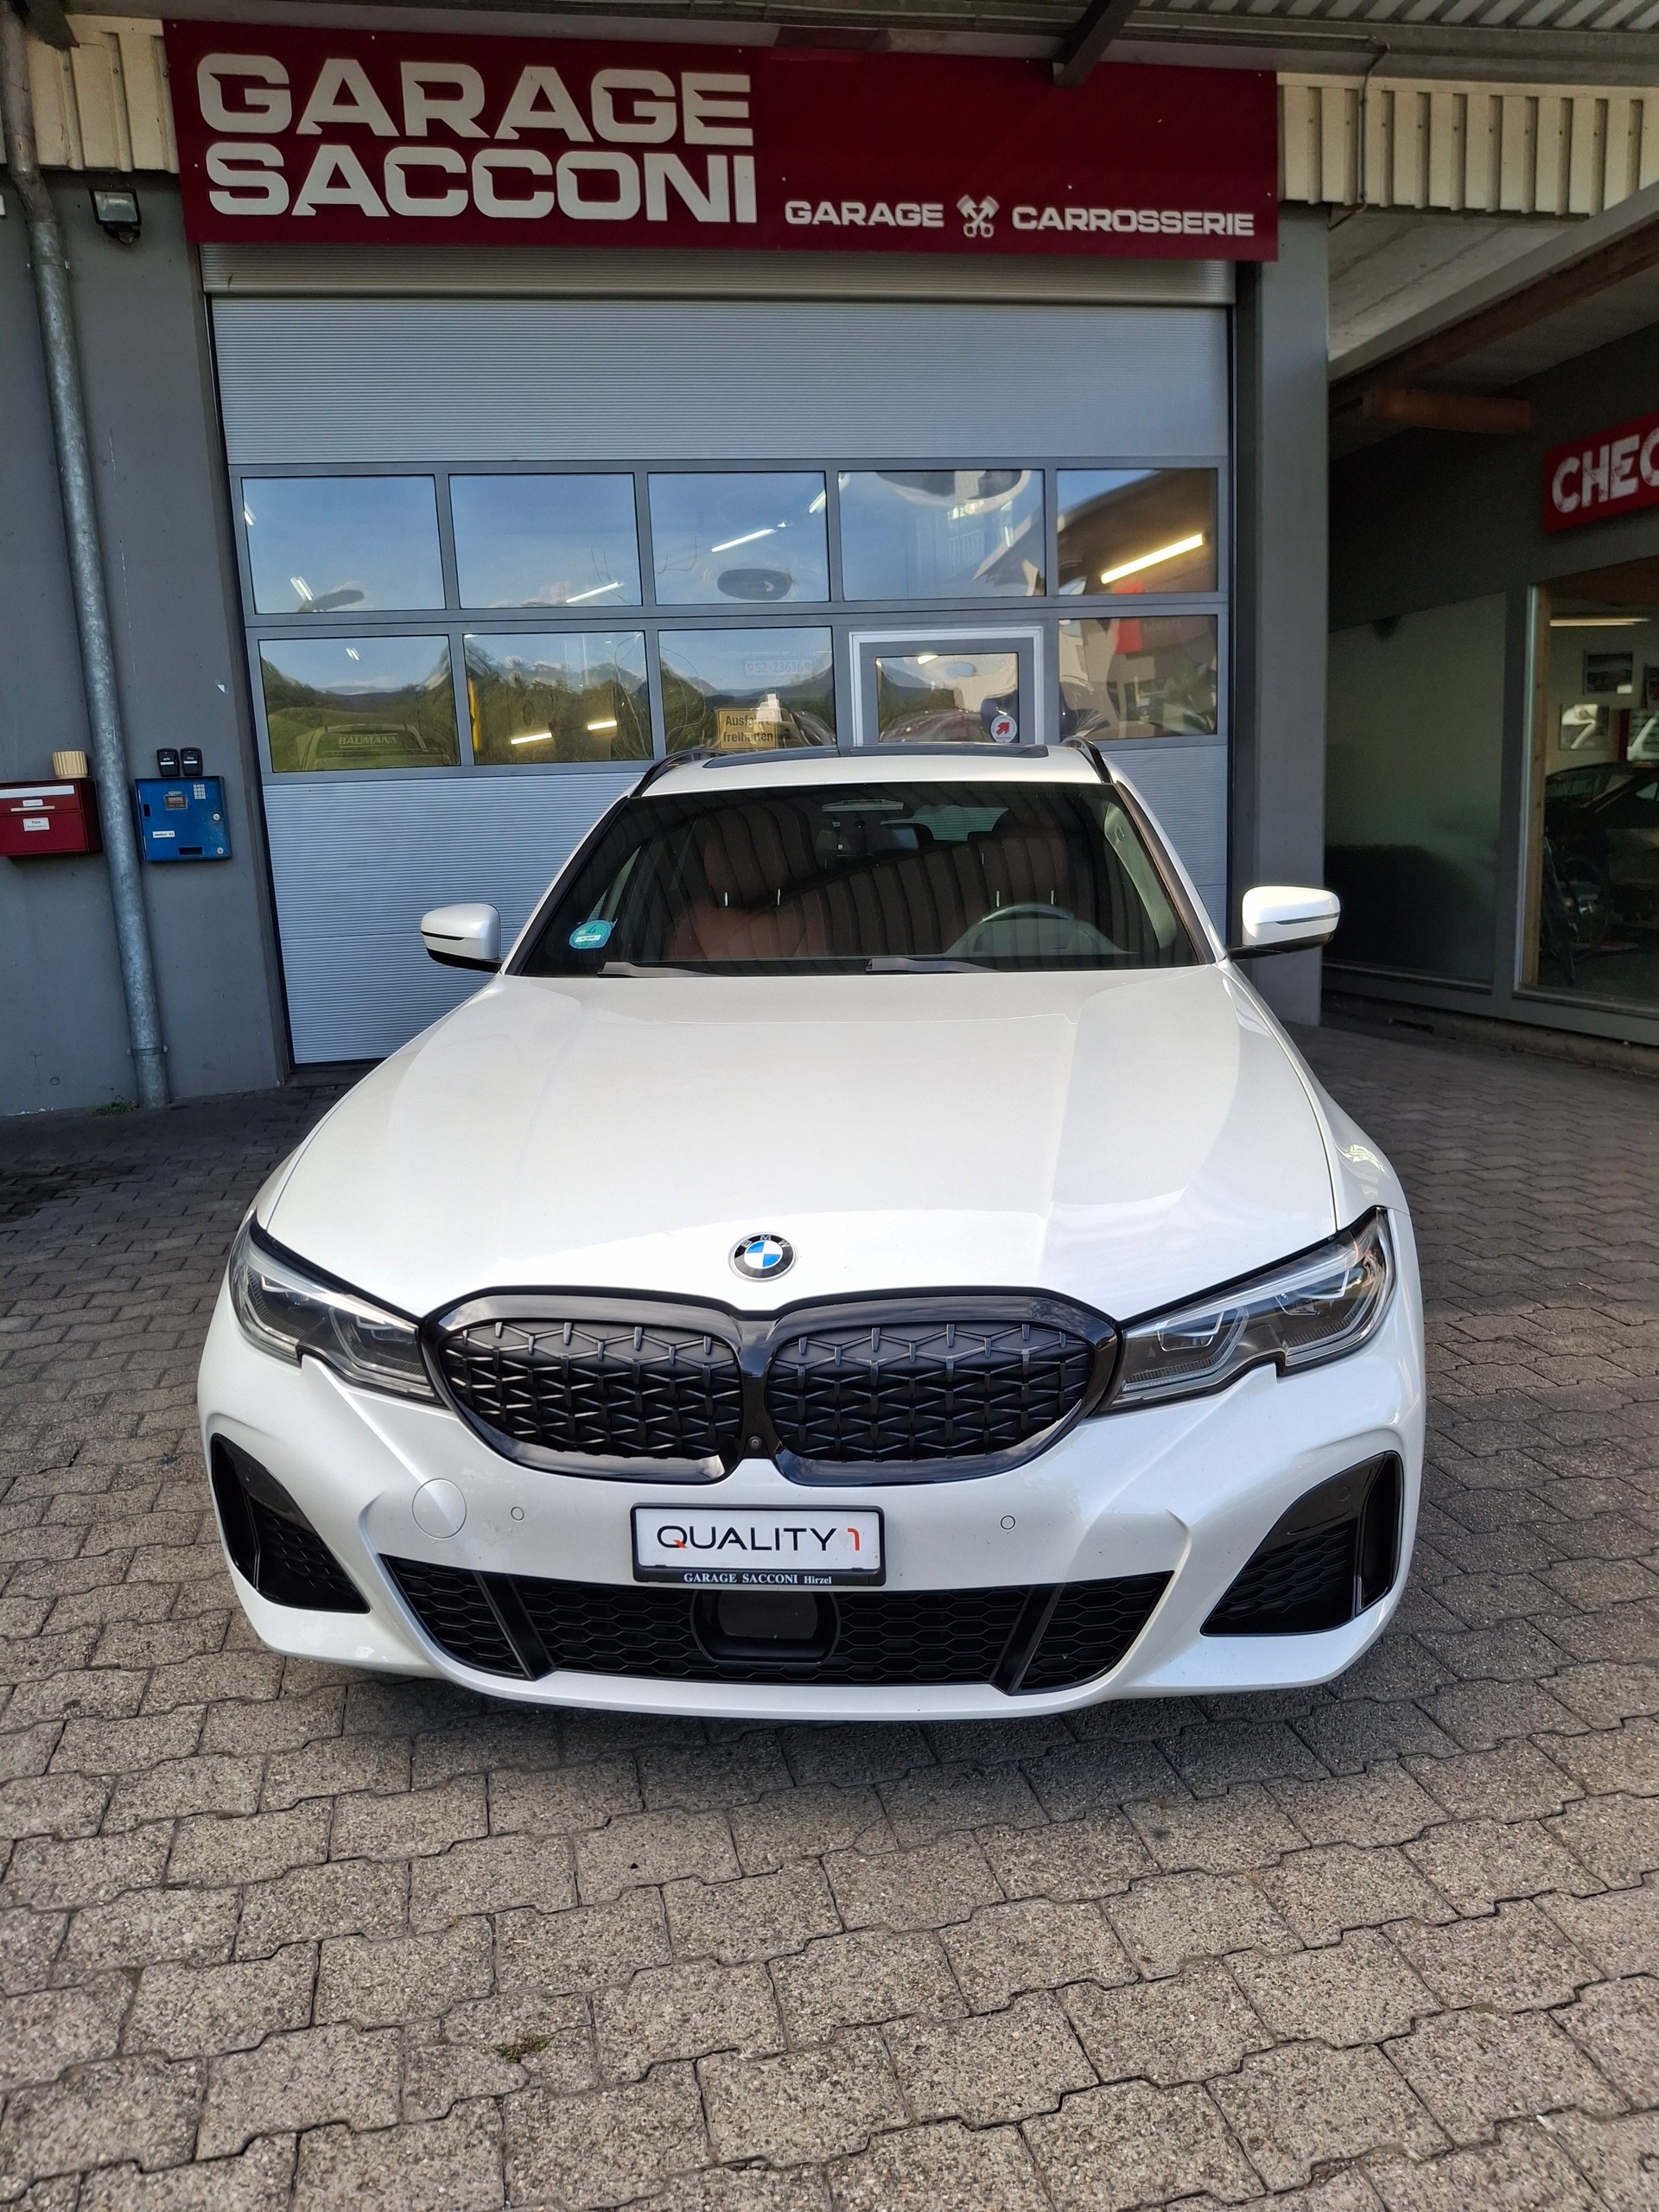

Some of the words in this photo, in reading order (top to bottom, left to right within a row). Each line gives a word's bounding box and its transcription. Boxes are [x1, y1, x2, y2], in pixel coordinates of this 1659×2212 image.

[196, 52, 754, 146] GARAGE
[206, 142, 758, 223] SACCONI
[784, 200, 944, 228] GARAGE
[1011, 206, 1255, 237] CARROSSERIE
[338, 735, 398, 745] BAUMANN
[741, 1234, 791, 1248] BMW
[657, 1525, 837, 1552] QUALITY
[847, 1528, 860, 1551] 1
[683, 1573, 737, 1583] GARAGE
[742, 1573, 798, 1585] SACCONI
[804, 1575, 832, 1585] Hirzel
